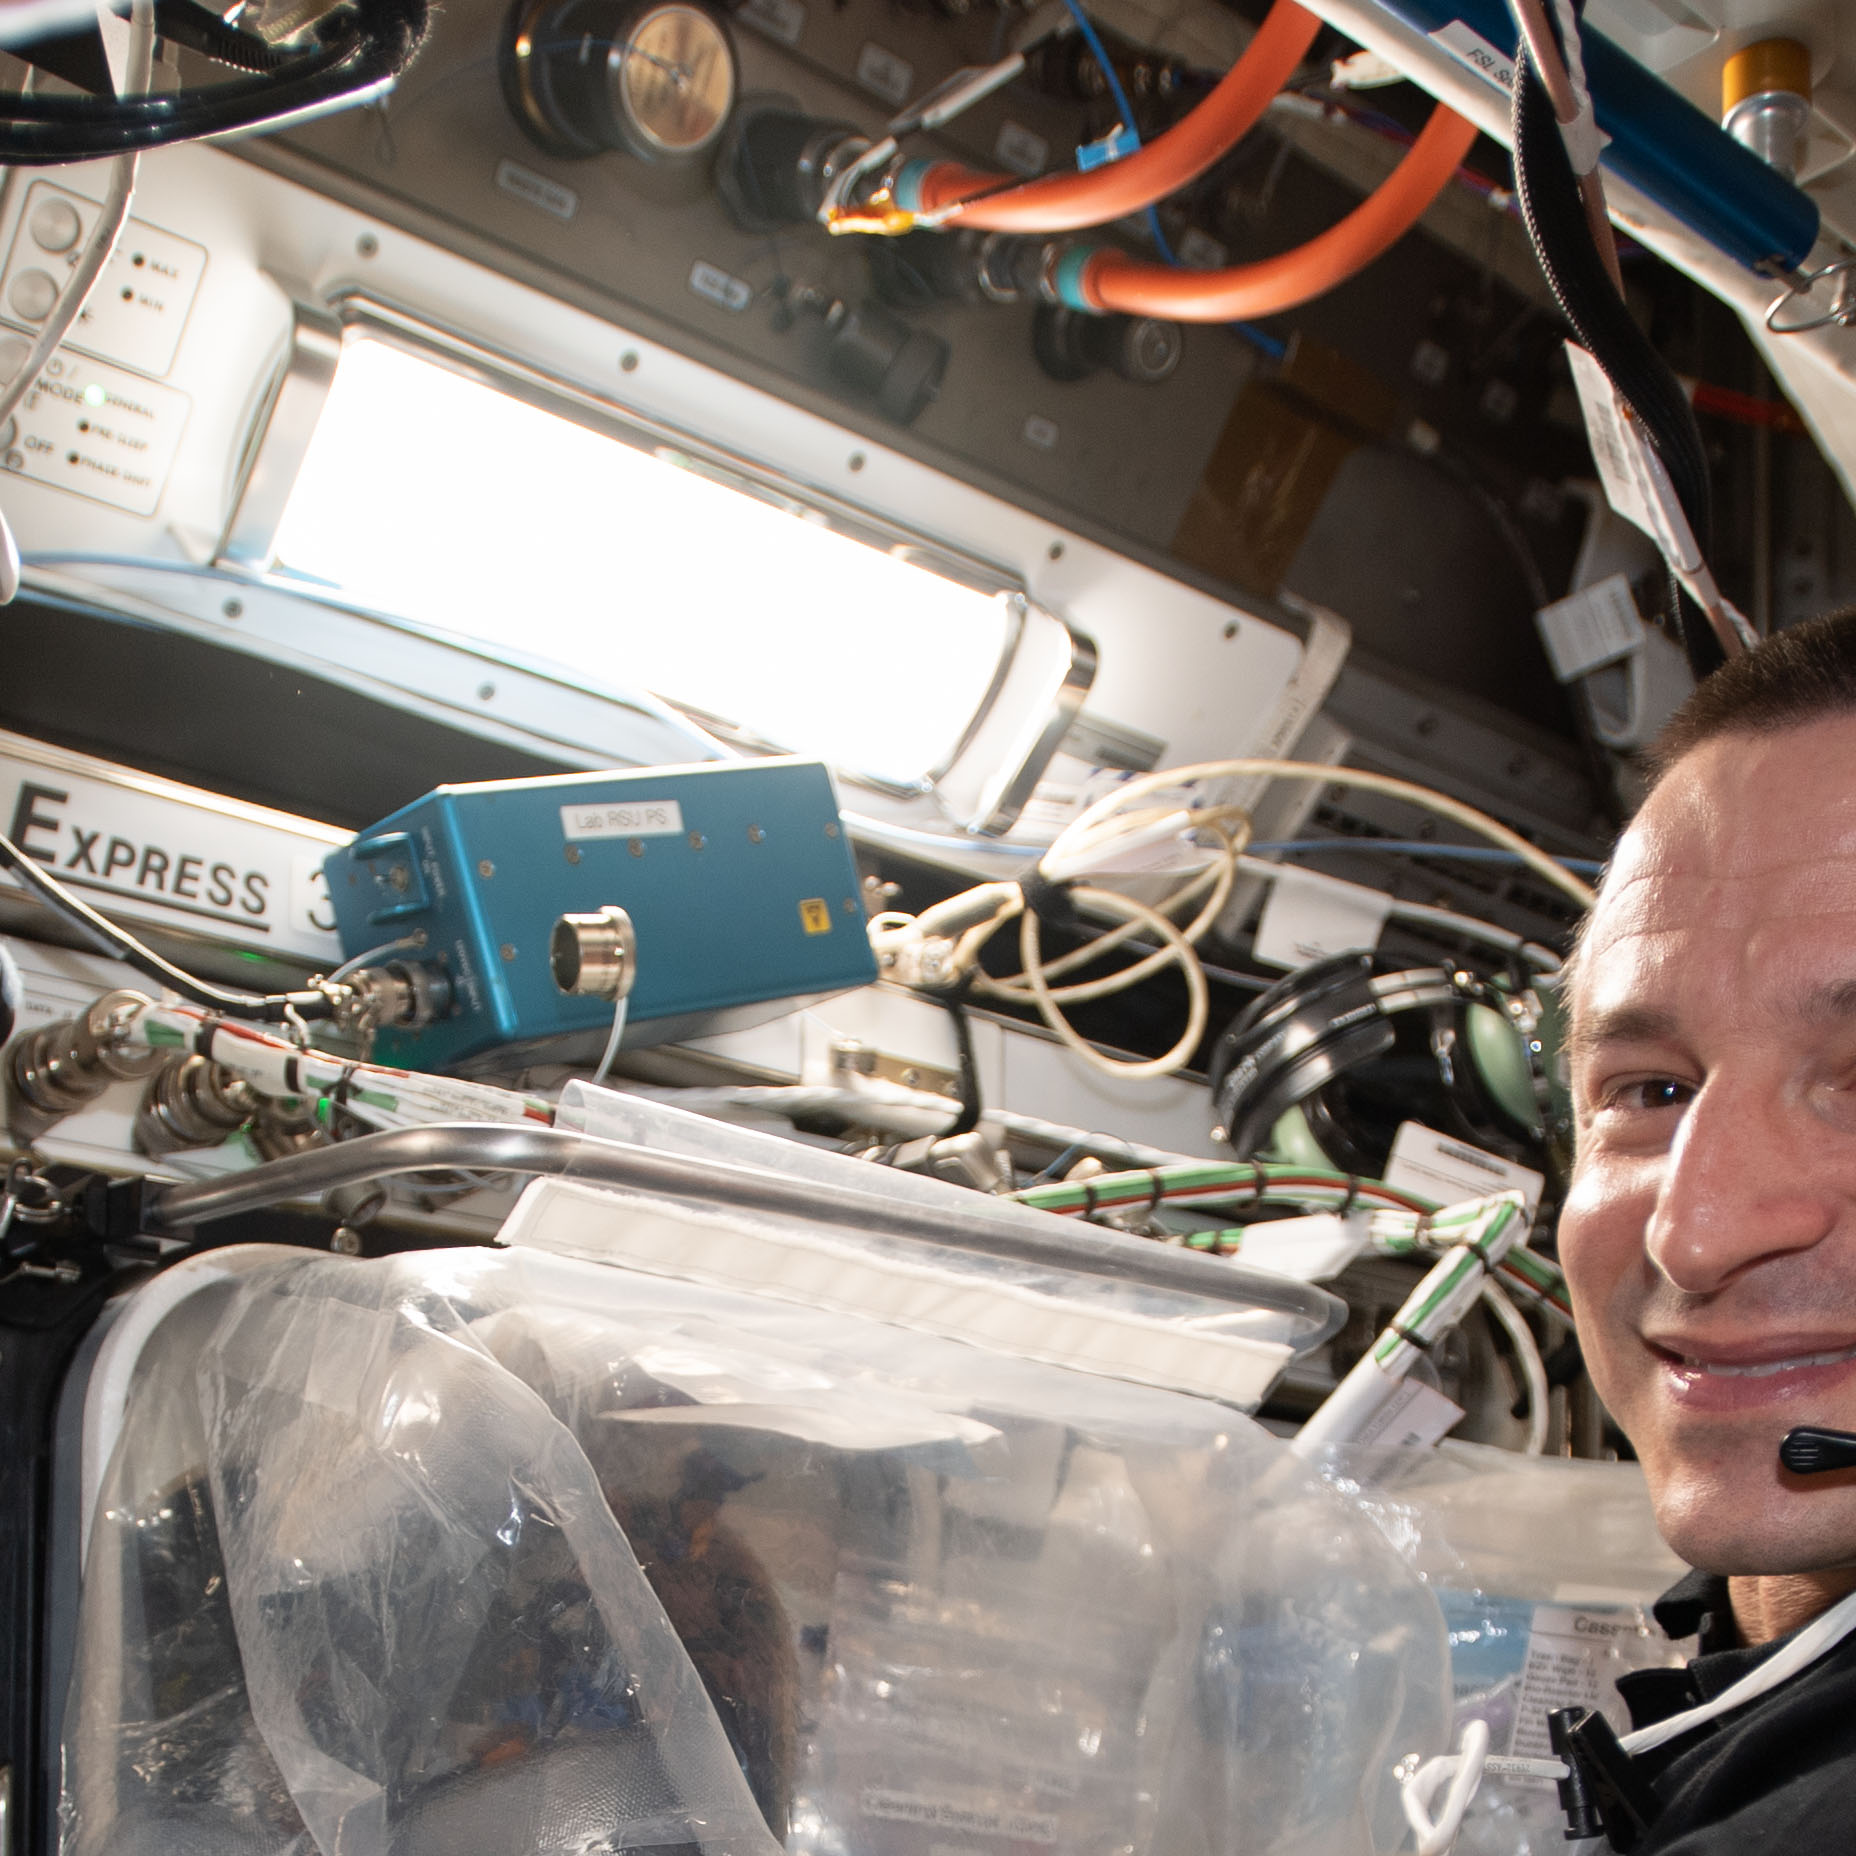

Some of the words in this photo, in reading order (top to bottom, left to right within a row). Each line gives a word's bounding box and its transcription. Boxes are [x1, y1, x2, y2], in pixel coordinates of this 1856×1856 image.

[36, 378, 85, 405] MODE
[24, 435, 55, 455] OFF
[576, 813, 603, 829] Lab
[608, 809, 641, 827] RSU
[646, 808, 667, 825] PS
[7, 780, 270, 916] EXPRESS
